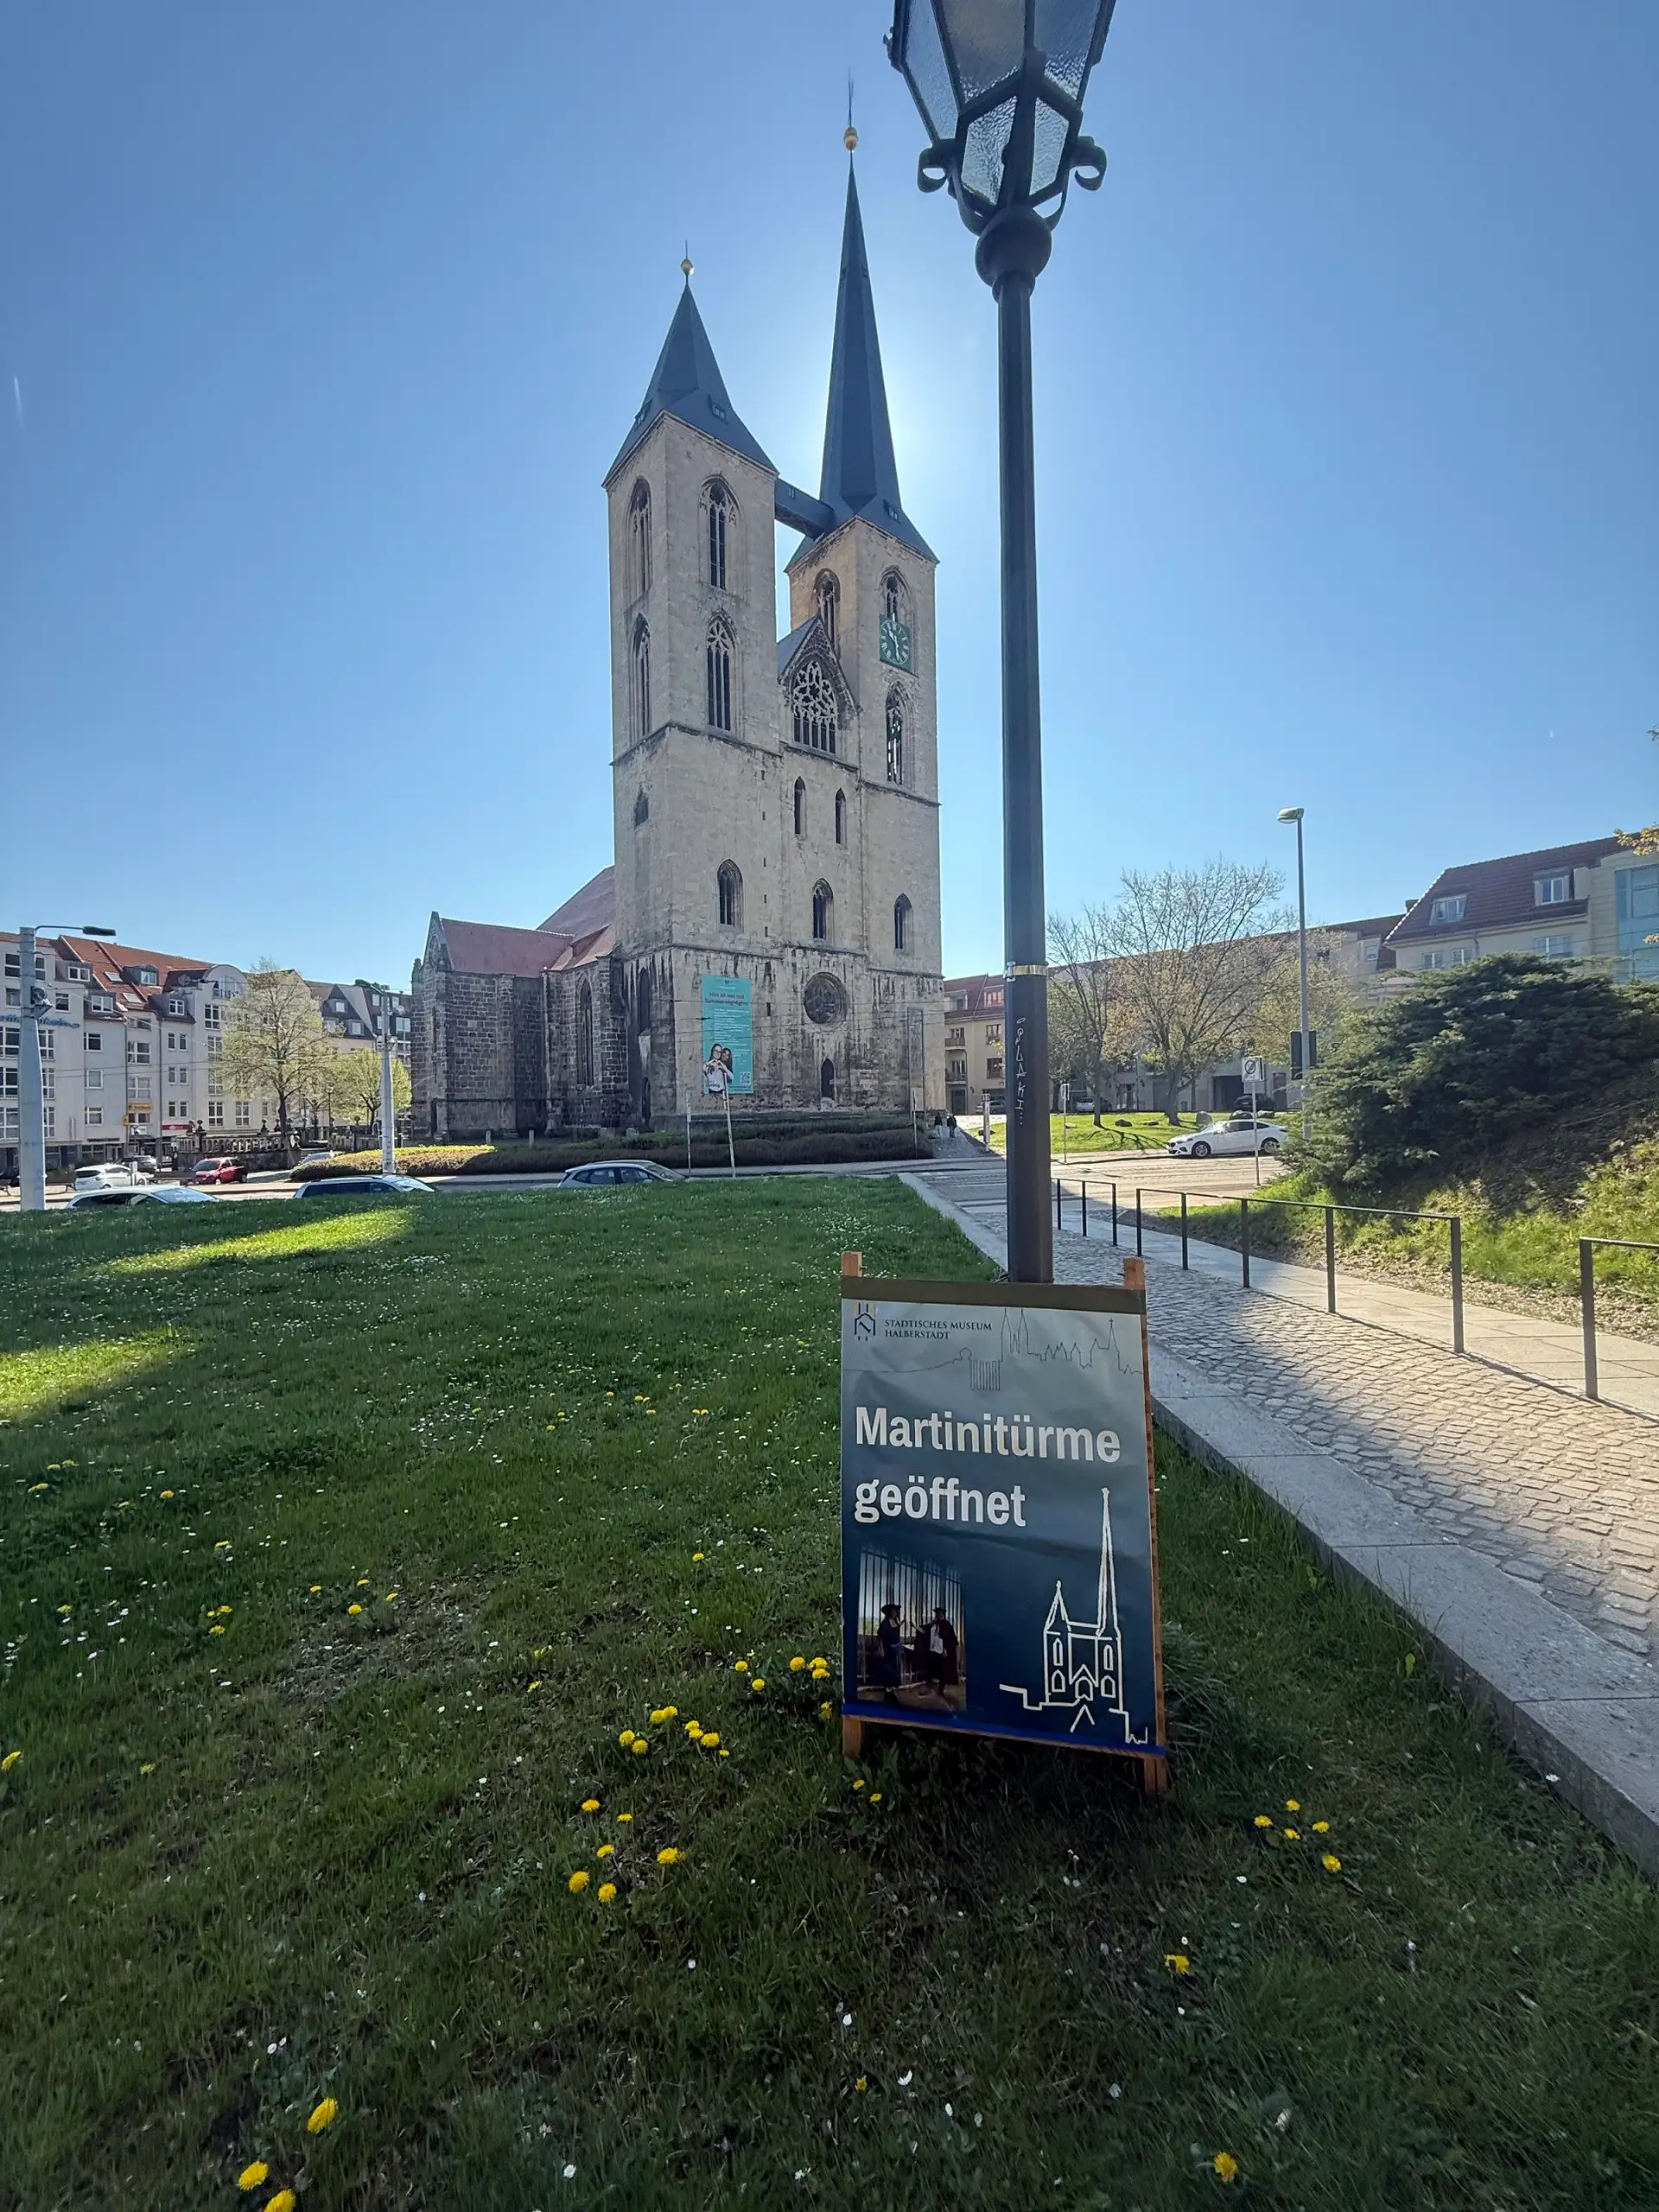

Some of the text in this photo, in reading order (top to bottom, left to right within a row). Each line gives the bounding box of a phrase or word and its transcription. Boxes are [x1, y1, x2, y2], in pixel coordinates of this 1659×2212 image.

[885, 1330, 950, 1340] HALBERSTADT
[950, 1321, 992, 1331] MUSEUM
[855, 1407, 1121, 1463] Martinitürme
[854, 1475, 1027, 1527] geöffnet
